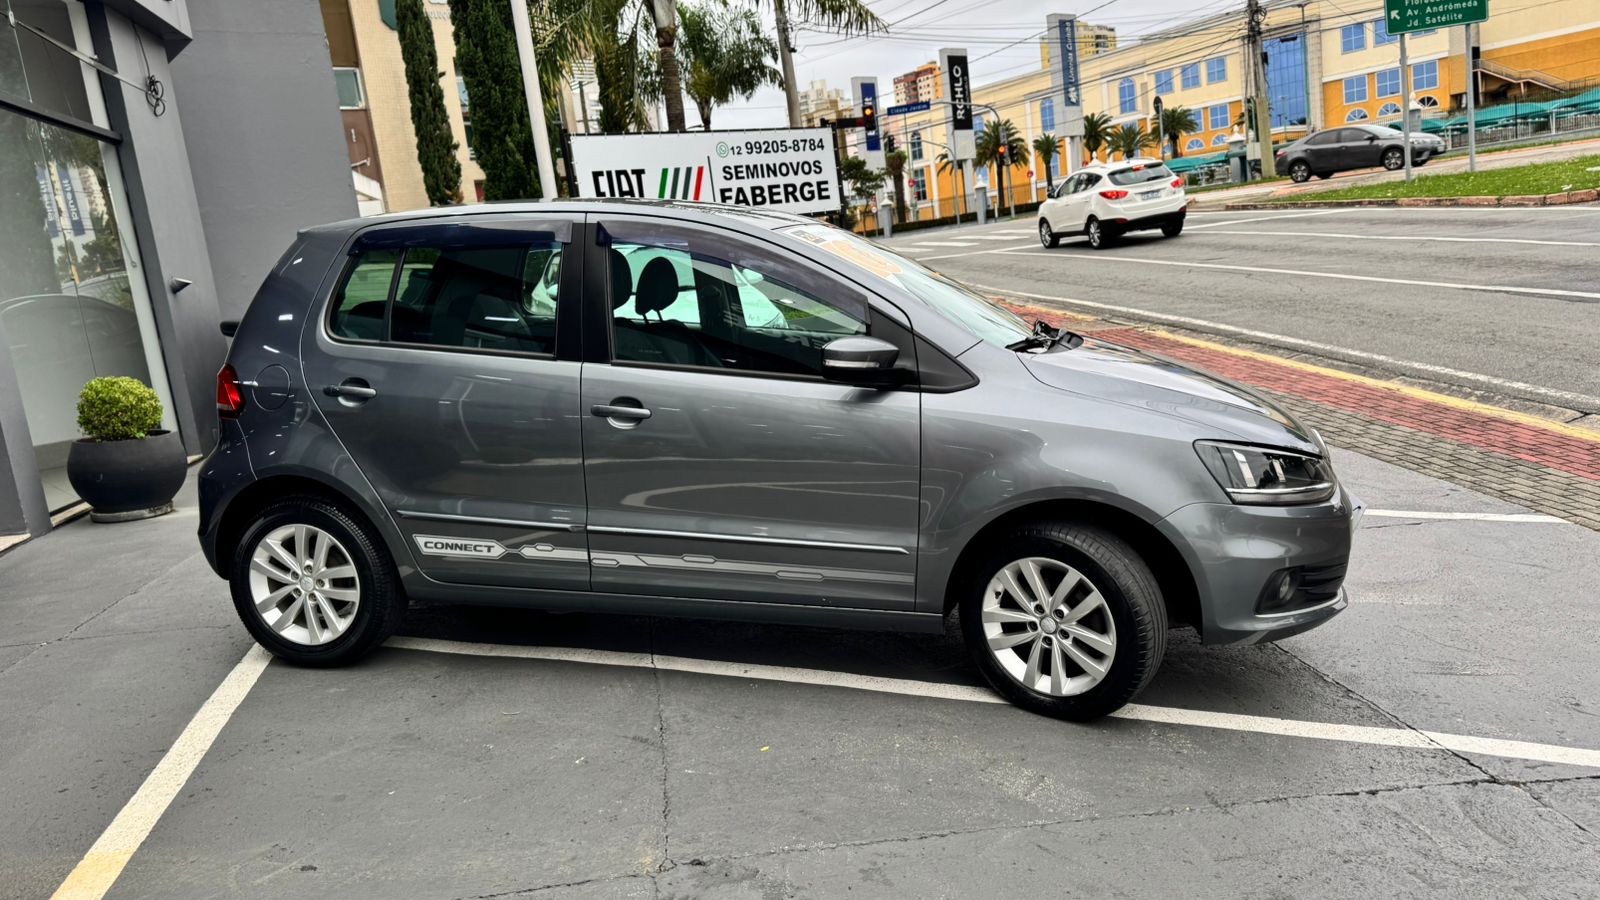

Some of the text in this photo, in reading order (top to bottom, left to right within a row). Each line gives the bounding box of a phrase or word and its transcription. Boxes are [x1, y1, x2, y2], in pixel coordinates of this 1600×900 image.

[1425, 1, 1477, 14] Andrômeda
[1406, 14, 1462, 27] Jd. Satélite
[953, 65, 965, 119] RCHLO
[730, 138, 824, 155] 12 99205-8784
[722, 160, 823, 181] SEMINOVOS
[592, 169, 646, 198] FIAT
[719, 180, 831, 206] FABERGE
[423, 541, 495, 553] CONNECT
